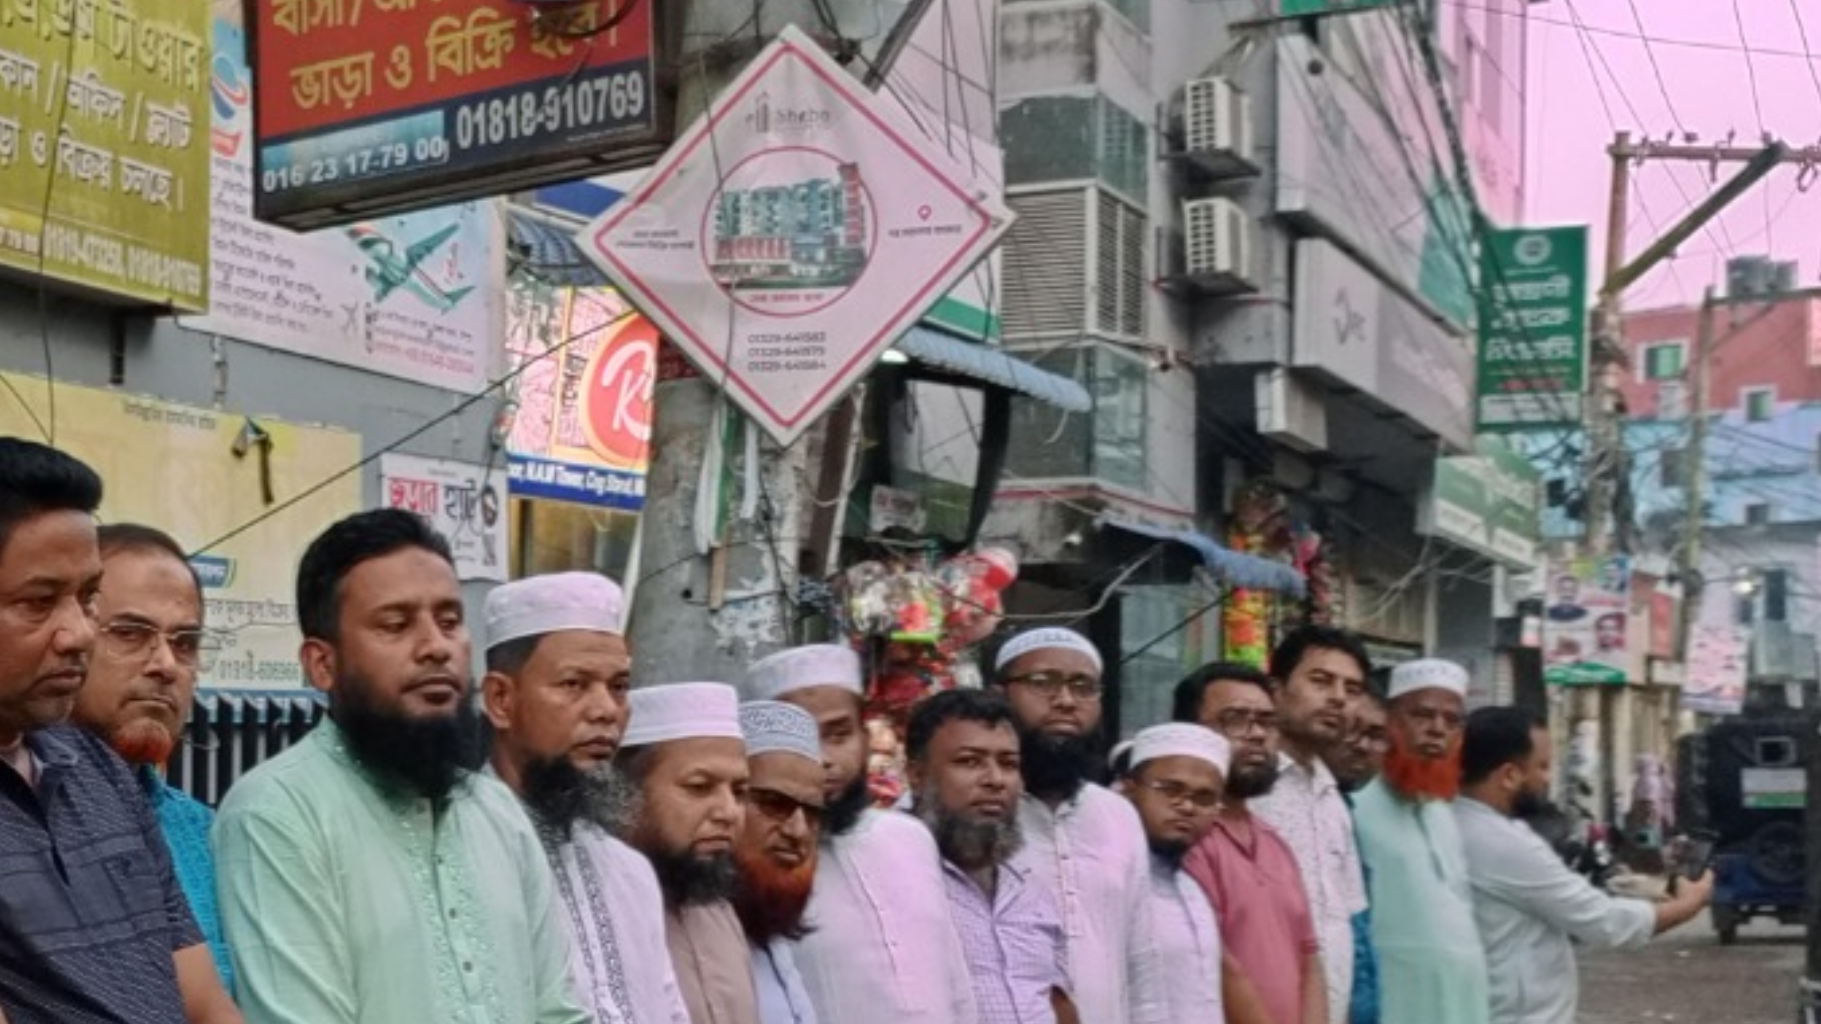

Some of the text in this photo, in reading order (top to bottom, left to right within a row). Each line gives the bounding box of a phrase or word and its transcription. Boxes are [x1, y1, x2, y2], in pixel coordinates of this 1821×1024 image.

[289, 50, 375, 110] ভাড়া
[384, 44, 414, 91] ও
[424, 8, 517, 84] বিক্রি
[261, 156, 305, 194] 016
[309, 154, 340, 183] 23
[454, 69, 645, 151] 01818-910769
